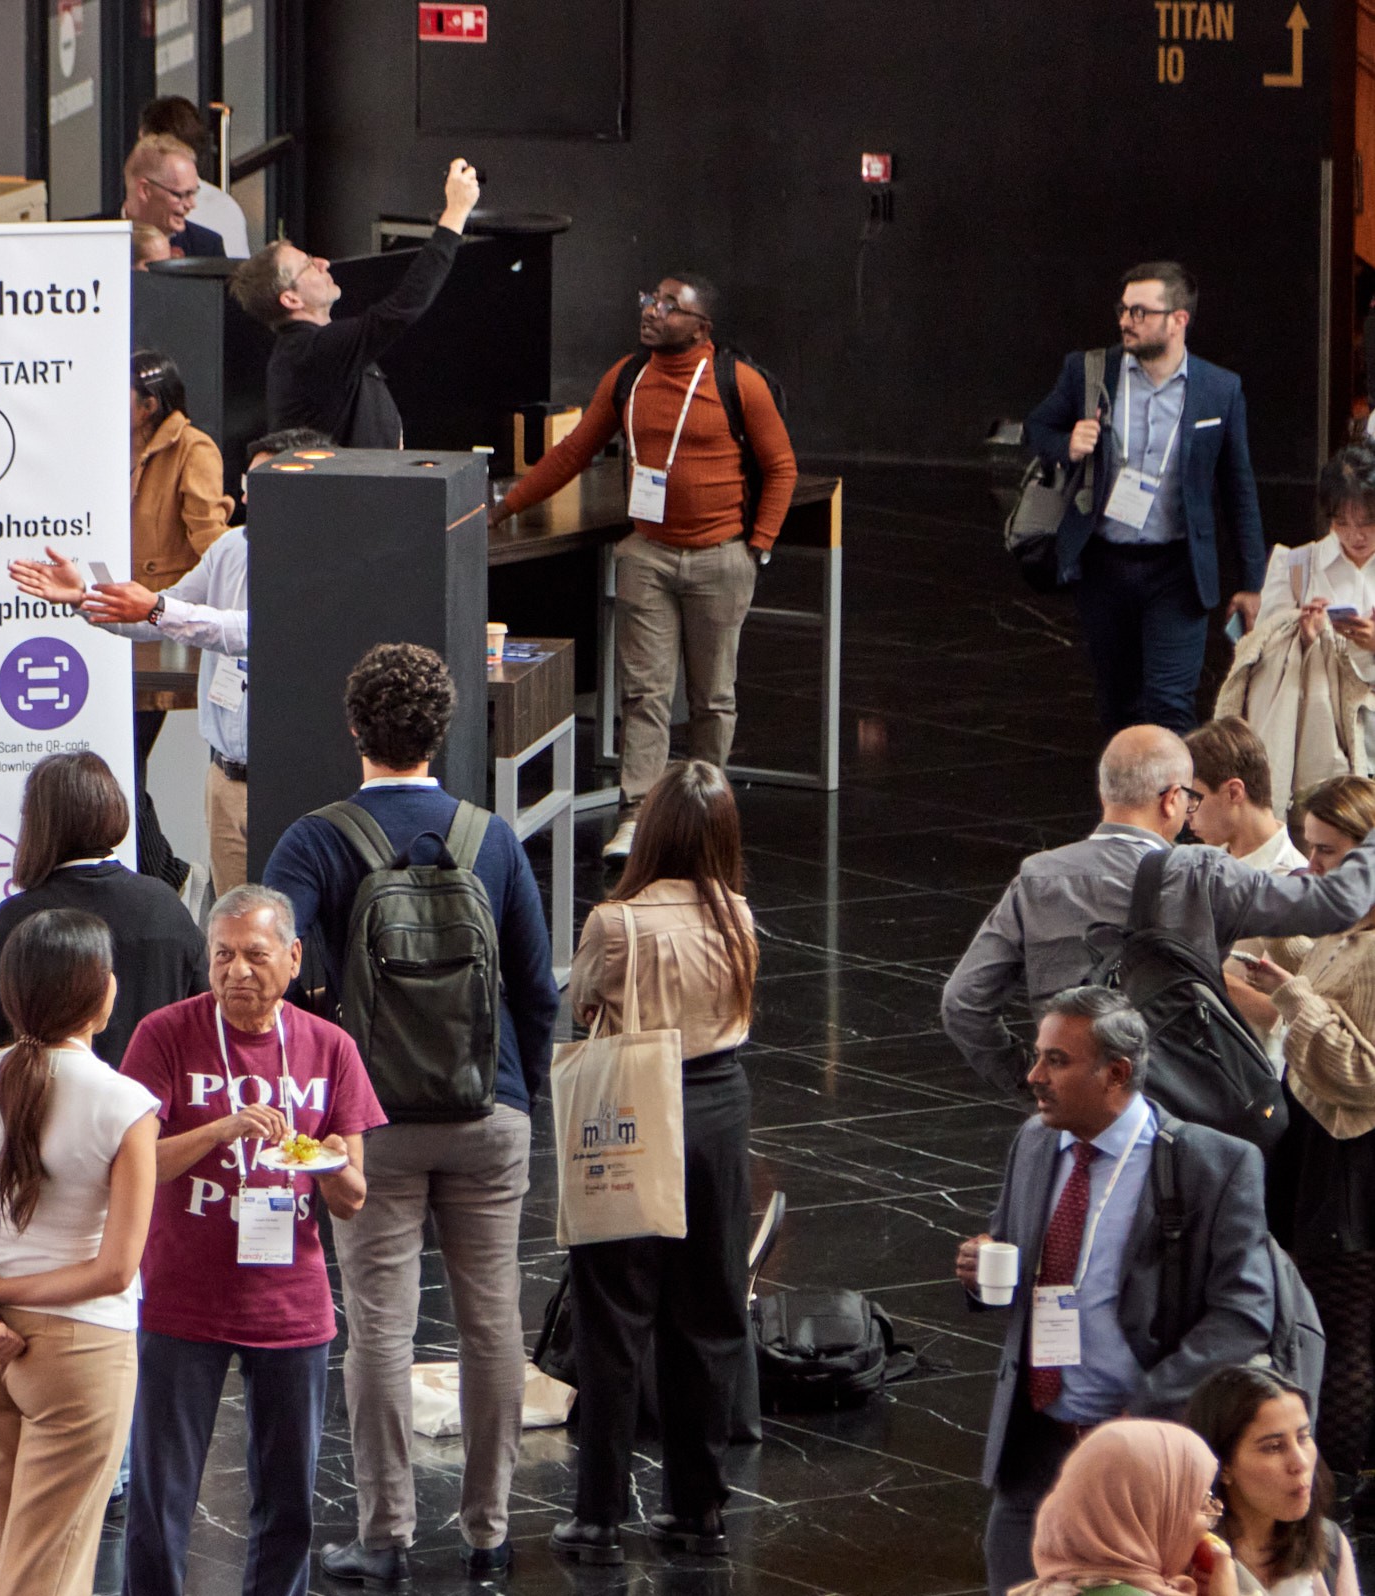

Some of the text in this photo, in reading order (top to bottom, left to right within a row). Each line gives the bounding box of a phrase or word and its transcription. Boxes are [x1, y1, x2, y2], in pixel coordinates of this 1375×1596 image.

[1154, 2, 1234, 41] TITAN
[26, 741, 43, 753] the
[45, 739, 90, 754] QR-code
[186, 1072, 328, 1111] POM
